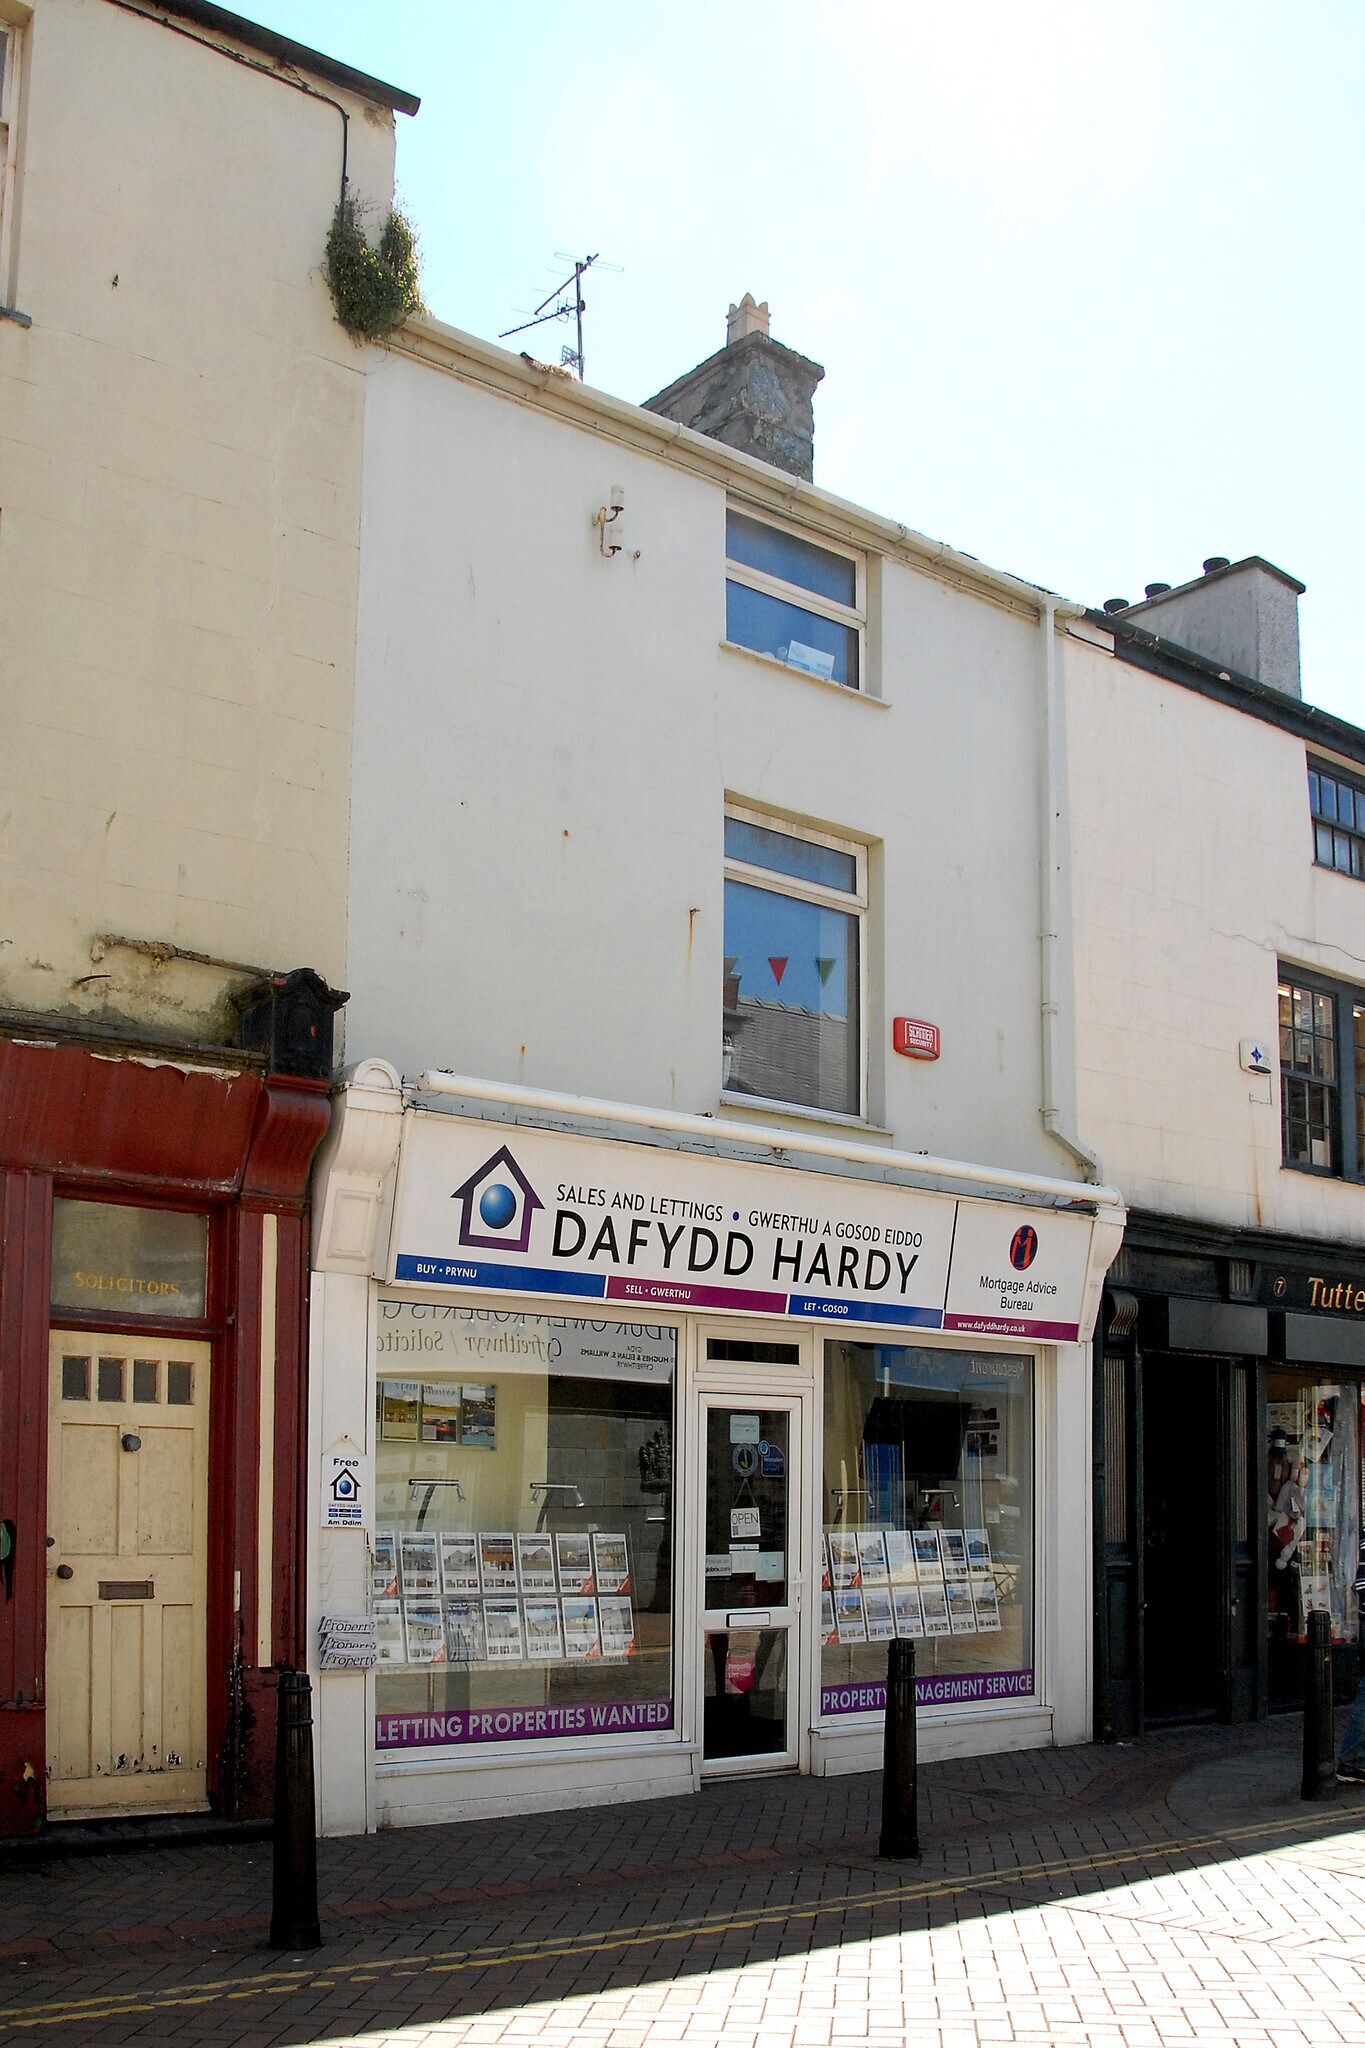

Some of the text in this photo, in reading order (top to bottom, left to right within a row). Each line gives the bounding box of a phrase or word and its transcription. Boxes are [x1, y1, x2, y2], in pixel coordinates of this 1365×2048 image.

[556, 1183, 923, 1248] SALES AND LETTINGS GWERTHU A GOSOD EIDDO
[551, 1208, 920, 1295] DAFYDD HARDY
[416, 1263, 478, 1279] BUY PRYNU
[74, 1271, 181, 1296] SOLICITORS
[979, 1275, 1058, 1295] Mortgage Advice
[1276, 1280, 1284, 1295] 7
[625, 1284, 691, 1299] SELL GWERTHU
[803, 1302, 849, 1315] LET GOSOD
[1000, 1296, 1034, 1311] Bureau
[957, 1320, 1027, 1334] www.dafyddhardy.co.uk
[333, 1458, 359, 1468] Free
[342, 1519, 362, 1527] Ddim
[732, 1512, 759, 1525] OPEN
[325, 1652, 378, 1669] Property
[822, 1674, 1033, 1710] PROPERTY NAGEMENT SERVICE
[376, 1703, 670, 1742] LETTING PROPERTIES WANTED
